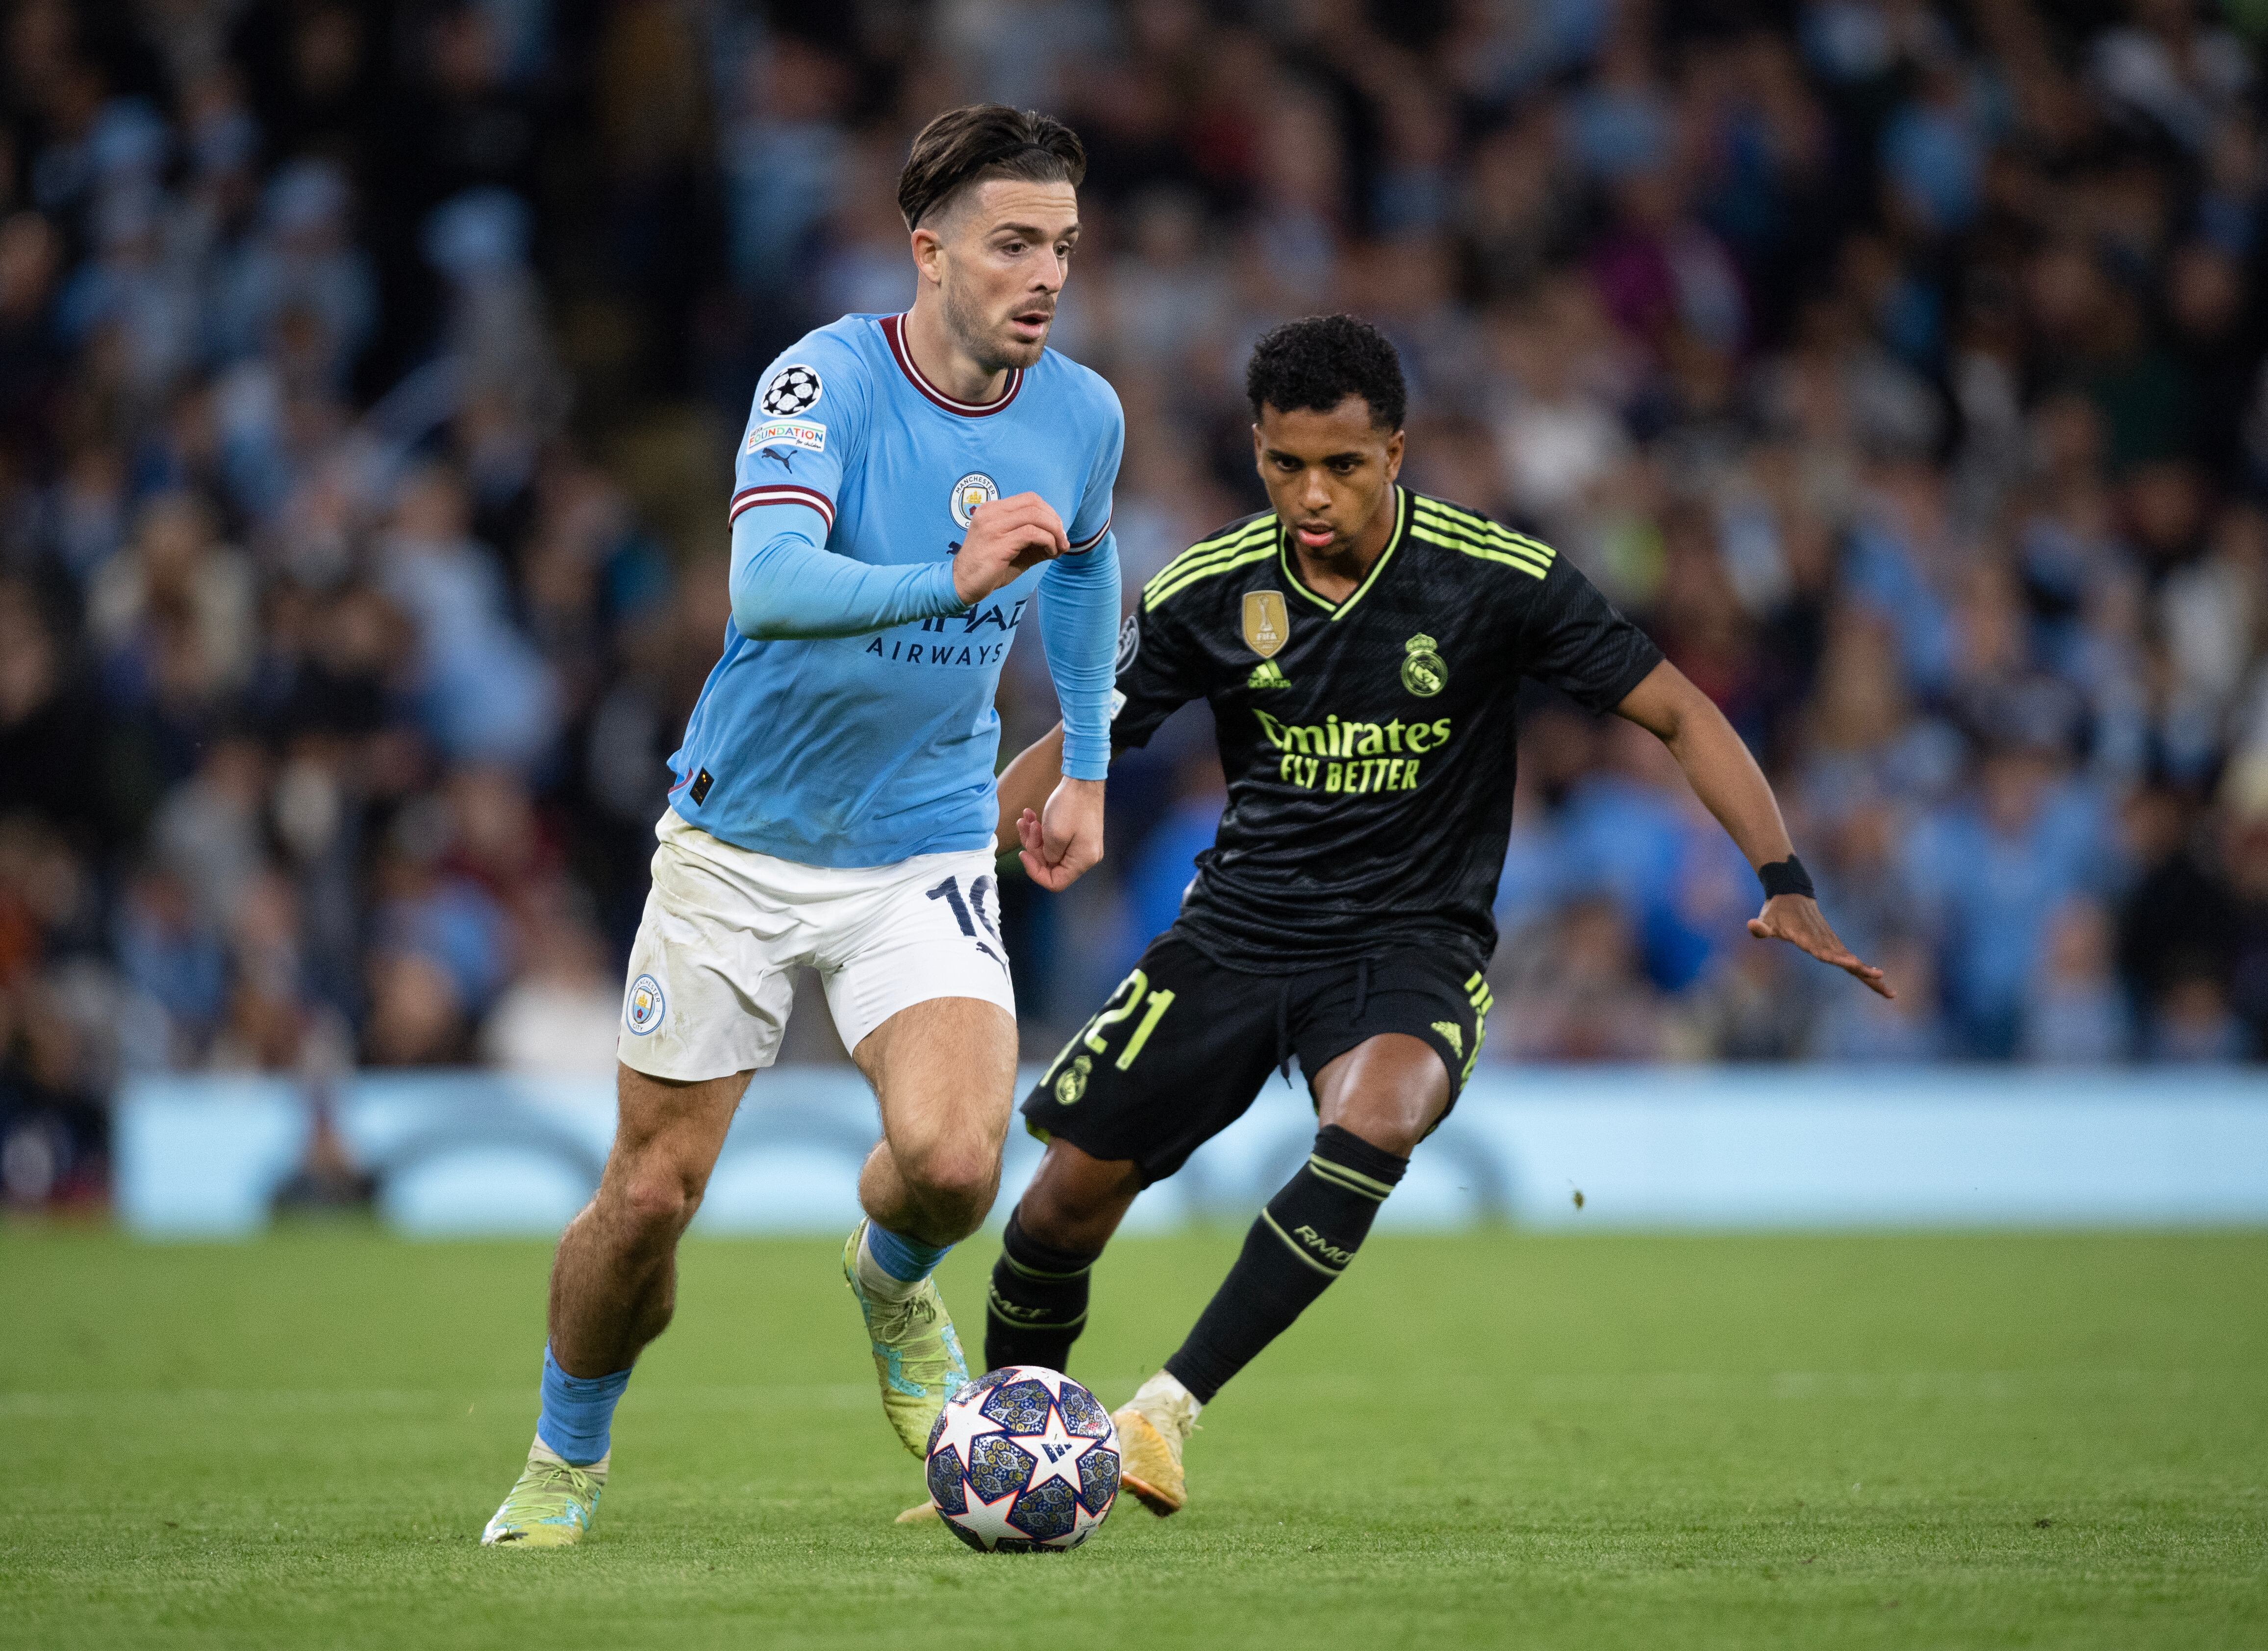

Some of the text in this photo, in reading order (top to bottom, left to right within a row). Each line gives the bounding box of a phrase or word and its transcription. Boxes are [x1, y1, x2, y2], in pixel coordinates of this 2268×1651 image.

[749, 427, 824, 446] FOUNDATION
[804, 441, 822, 449] children
[956, 476, 995, 495] MANCHESTER
[866, 637, 1003, 665] AIRWAYS
[1252, 708, 1452, 759] Emirates
[1280, 754, 1421, 794] FLY BETTER
[926, 874, 1007, 952] 10
[634, 979, 660, 1003] MANCHESTER
[632, 1023, 643, 1032] CITY
[1084, 968, 1176, 1071] 21
